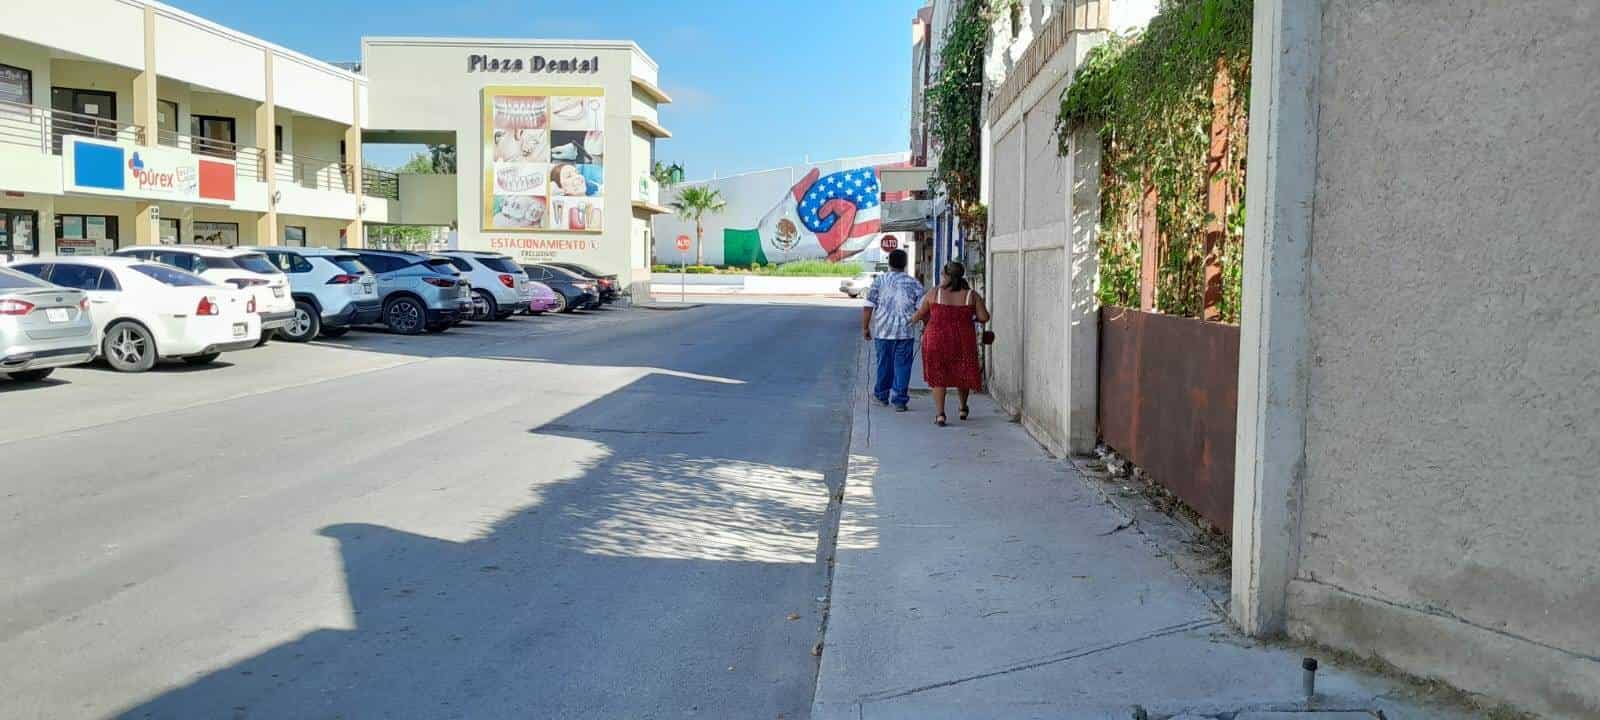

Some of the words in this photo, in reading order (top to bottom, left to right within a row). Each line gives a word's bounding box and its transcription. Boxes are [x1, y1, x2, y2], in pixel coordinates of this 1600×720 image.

[467, 54, 523, 73] Plaza
[529, 55, 599, 74] Dental
[490, 238, 586, 250] ESTACIONAMIENTO
[676, 239, 690, 247] ALTO
[882, 239, 897, 248] ALTO
